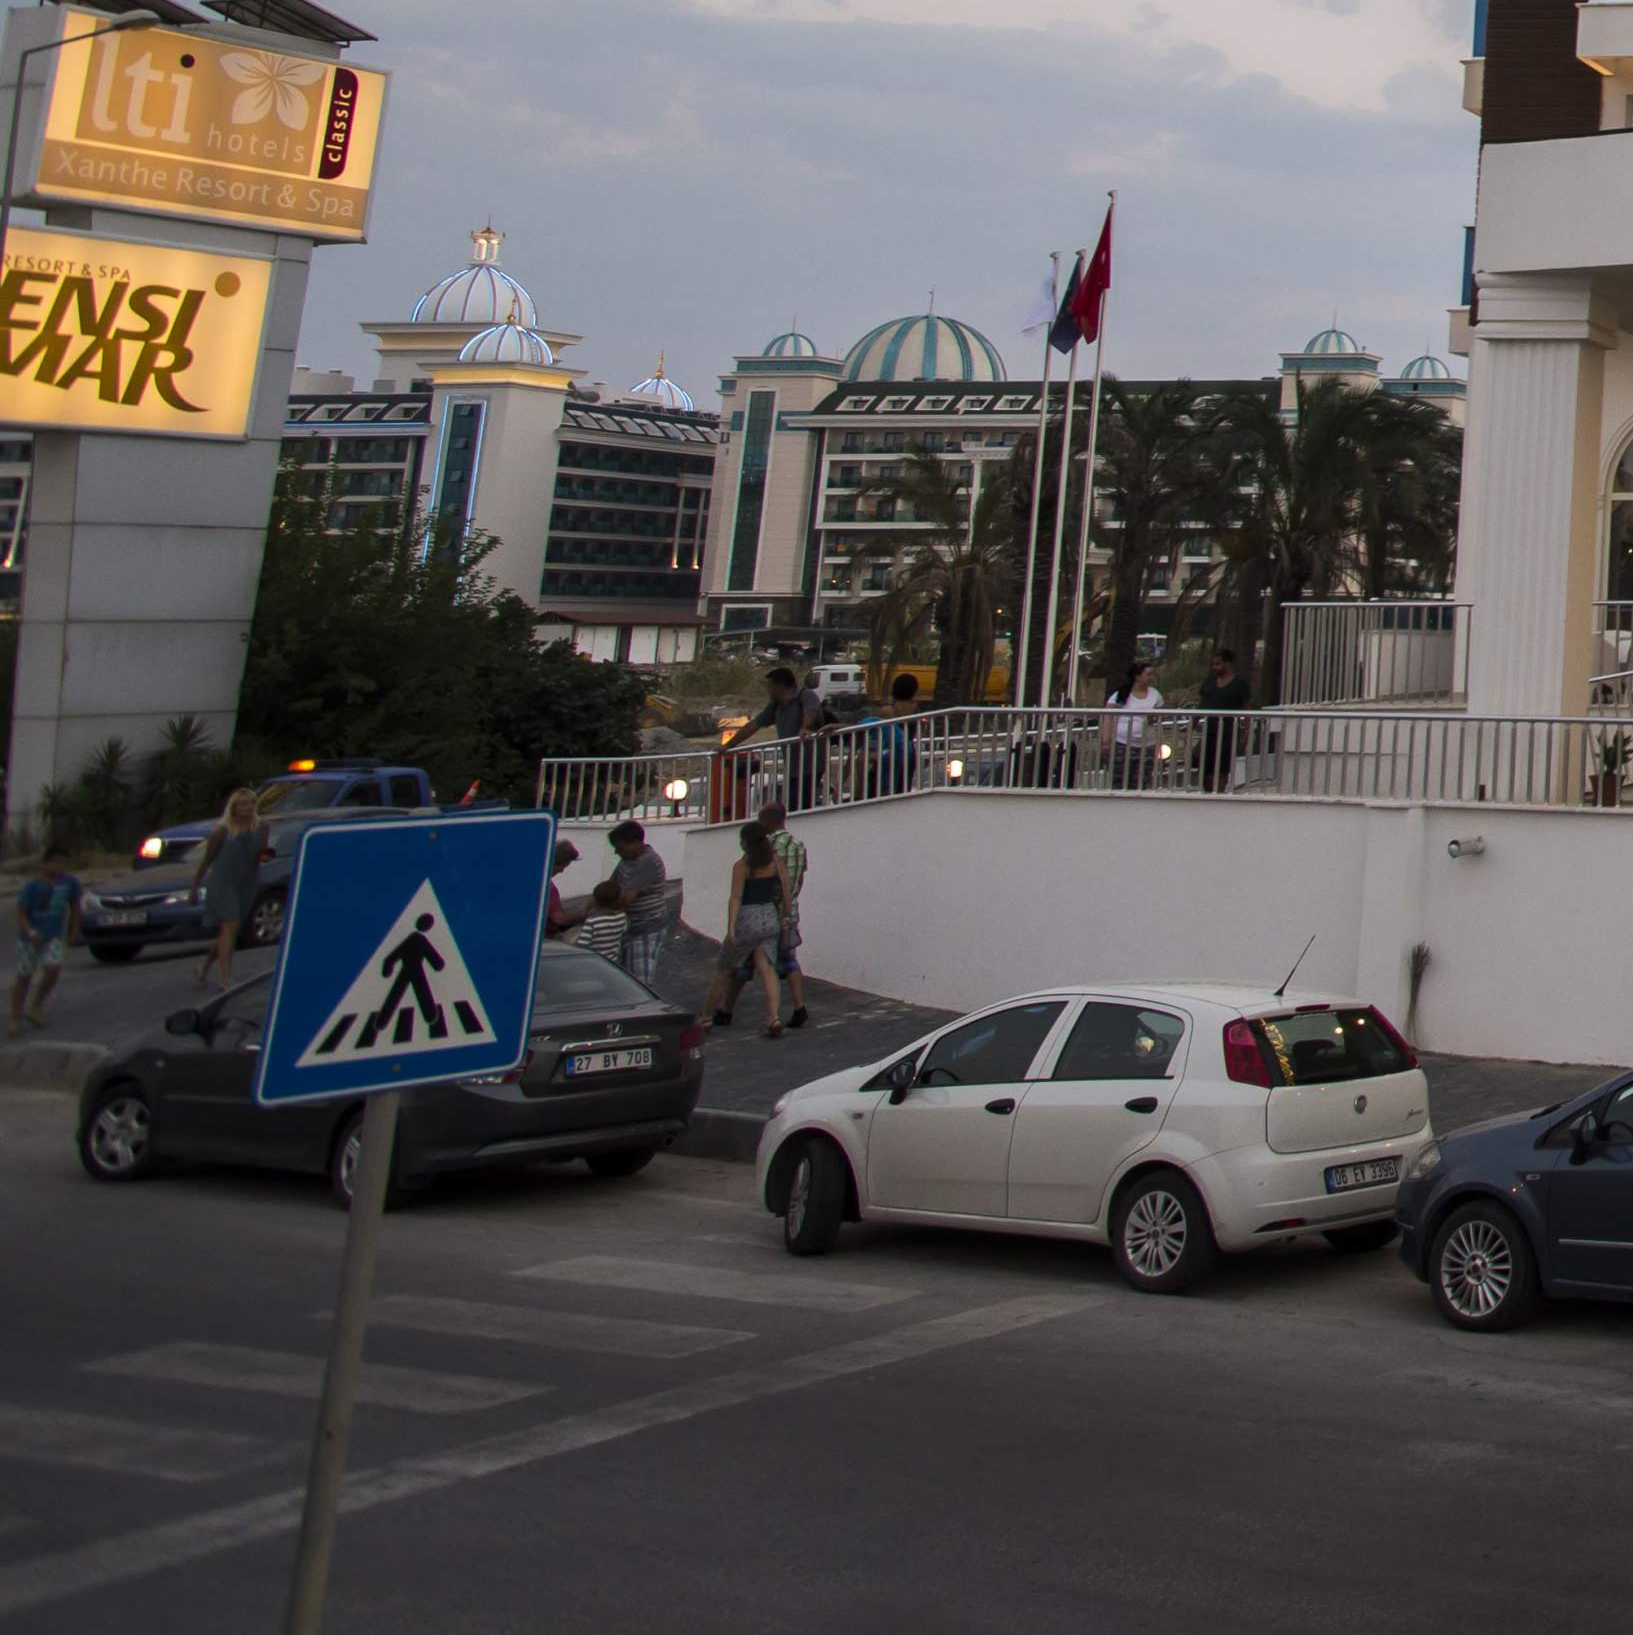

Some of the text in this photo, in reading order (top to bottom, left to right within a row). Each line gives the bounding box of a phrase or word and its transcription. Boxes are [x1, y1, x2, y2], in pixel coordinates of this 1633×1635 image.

[92, 30, 194, 145] lti
[206, 123, 306, 164] hotels
[327, 87, 354, 163] classic
[55, 149, 355, 219] Xanthe Resort & Spa
[81, 263, 92, 277] &
[98, 264, 131, 282] SPA
[576, 1056, 592, 1072] 27
[626, 1050, 650, 1066] 708
[1334, 1167, 1348, 1186] 06
